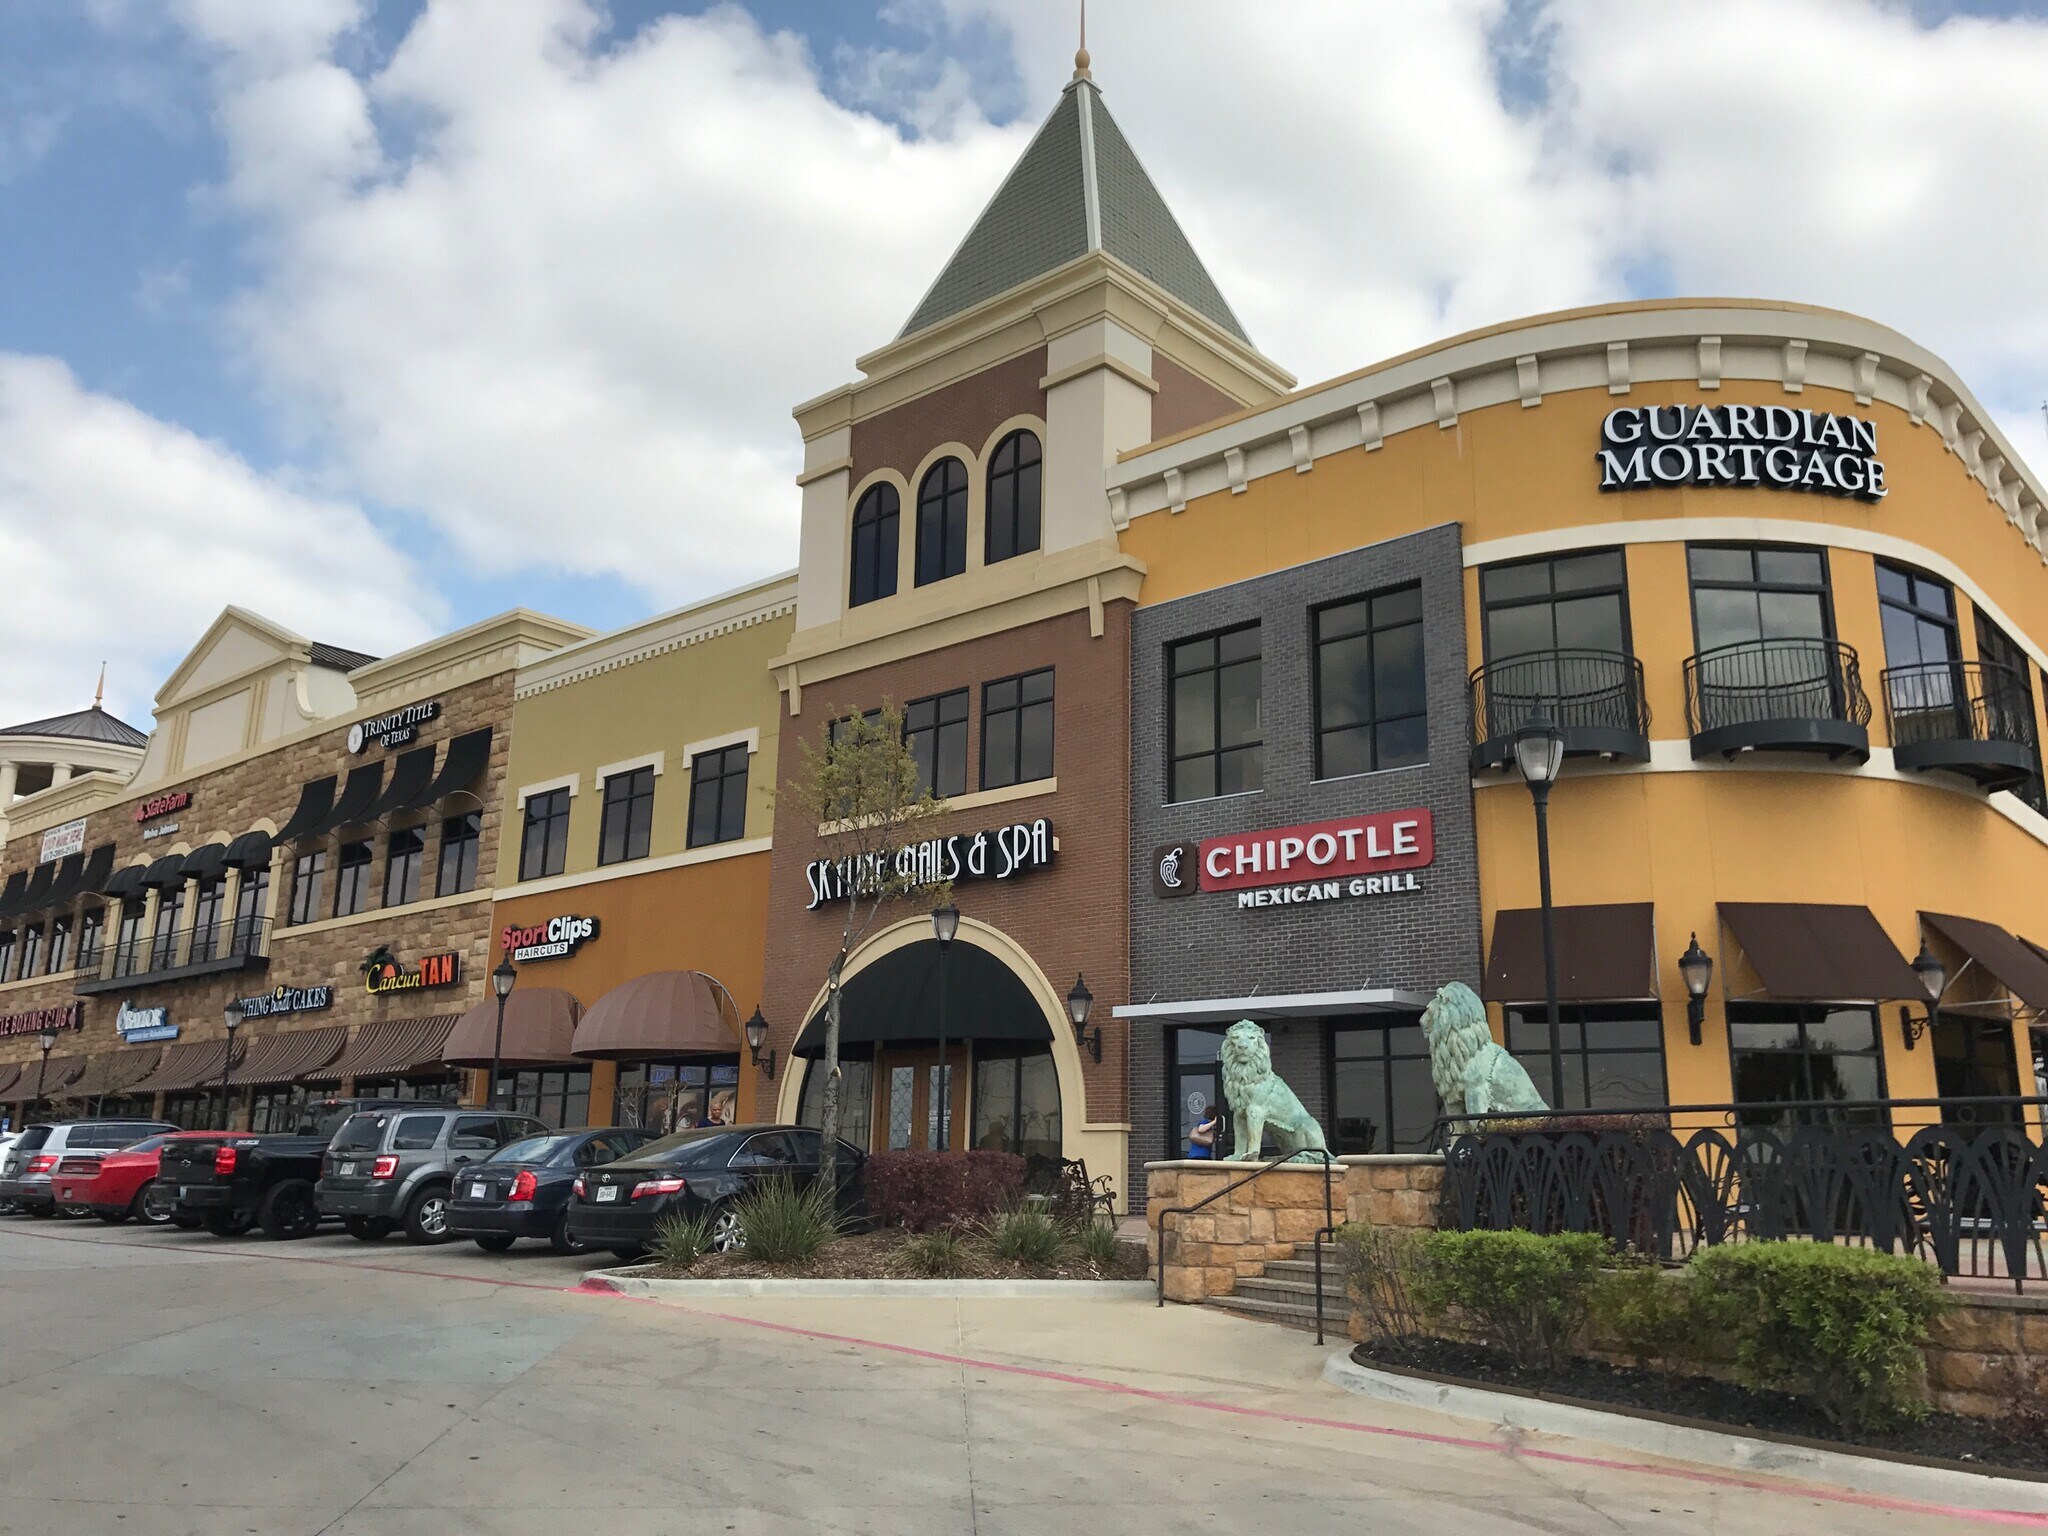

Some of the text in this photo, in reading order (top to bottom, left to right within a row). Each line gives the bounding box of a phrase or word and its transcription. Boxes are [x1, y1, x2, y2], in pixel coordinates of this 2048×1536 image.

[1603, 403, 1877, 455] GUARDIAN
[1599, 444, 1889, 497] MORTGAGE
[363, 702, 434, 738] TRINITY TITLE
[380, 728, 410, 747] OF TEXAS
[895, 835, 960, 893] NAILS
[967, 832, 988, 875] &
[996, 818, 1047, 878] SPA
[1205, 820, 1420, 878] CHIPOTLE
[1238, 873, 1421, 909] MEXICAN GRILL
[516, 943, 566, 959] HAIRCUTS
[239, 994, 270, 1017] THING
[292, 987, 328, 1010] CAKES
[10, 1011, 44, 1034] BOXING
[44, 1007, 68, 1028] CLUB
